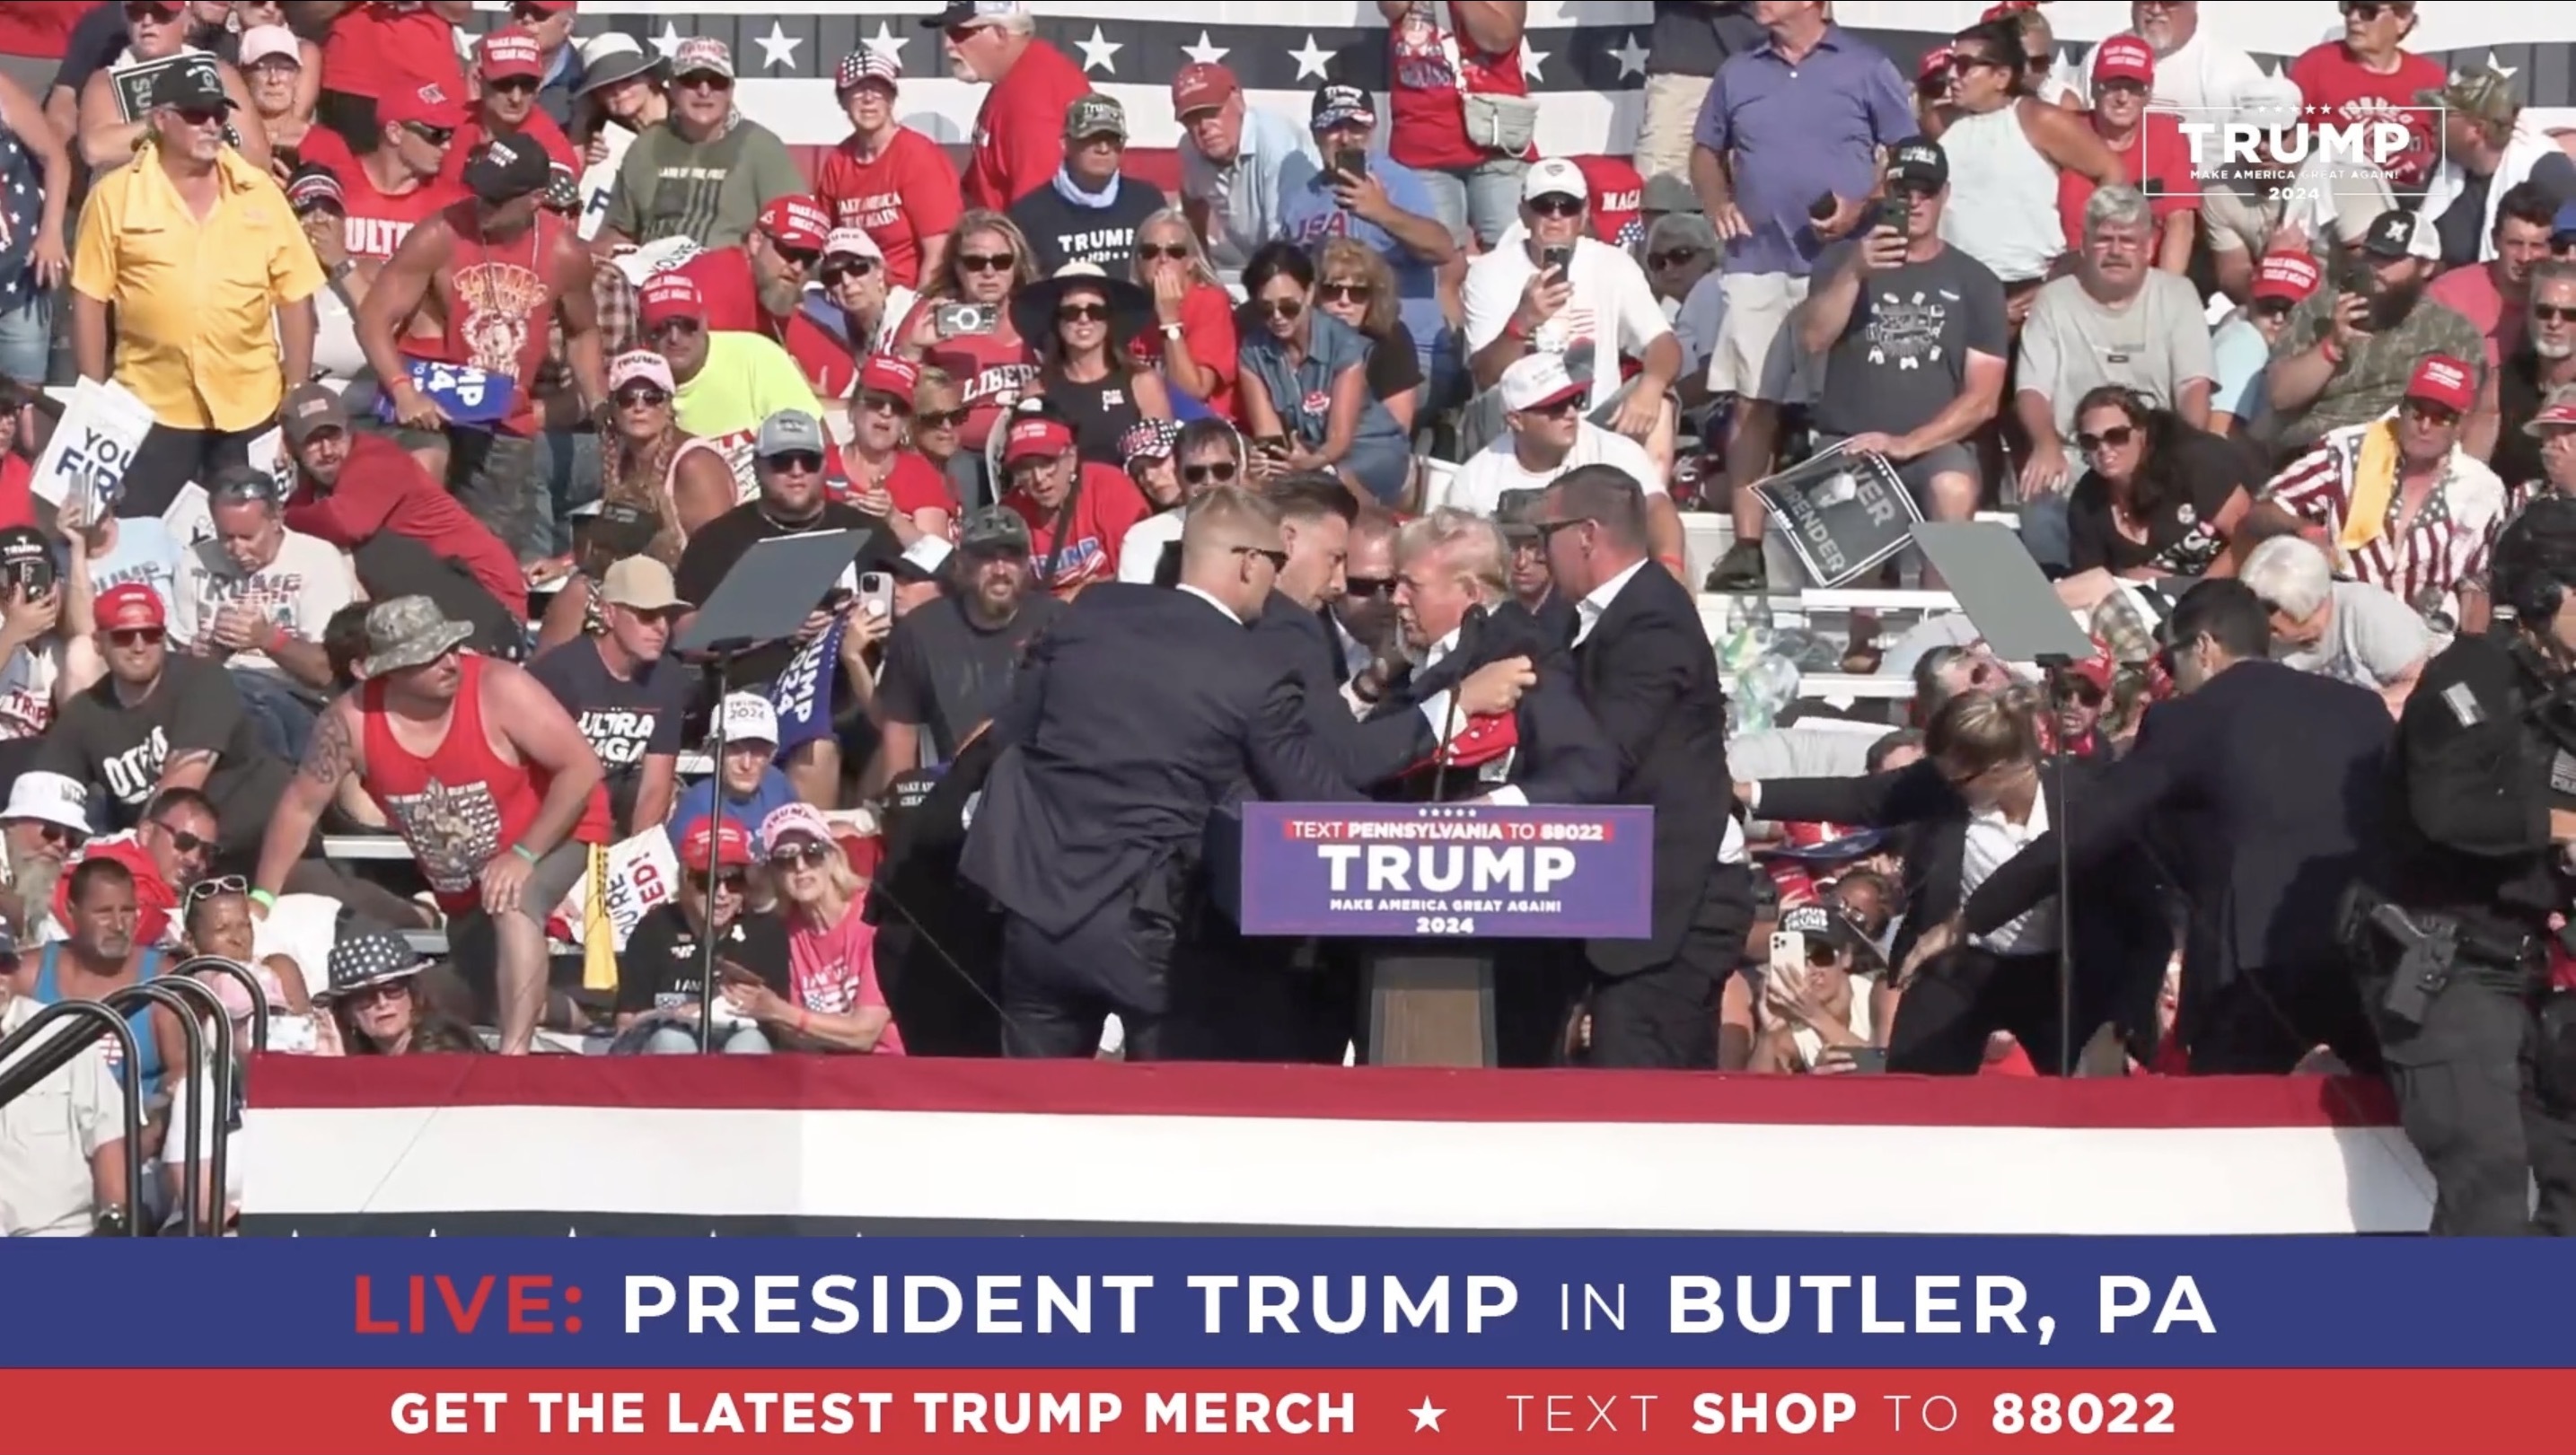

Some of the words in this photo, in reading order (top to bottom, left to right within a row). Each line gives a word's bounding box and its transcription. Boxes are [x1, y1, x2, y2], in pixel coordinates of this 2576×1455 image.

[1844, 460, 1896, 528] VER
[577, 711, 655, 738] ULTRA
[587, 737, 647, 763] AGA
[1293, 821, 1342, 838] TEXT
[1348, 821, 1503, 840] PENNSYLVANIA
[1508, 822, 1535, 840] TO
[1540, 823, 1604, 841] 88022
[1317, 845, 1576, 892] TRUMP
[1330, 898, 1374, 911] MAKE
[1377, 898, 1448, 912] AMERICA
[1452, 899, 1503, 912] GREAT
[1507, 899, 1561, 913] AGAIN!
[1416, 916, 1474, 934] 2024
